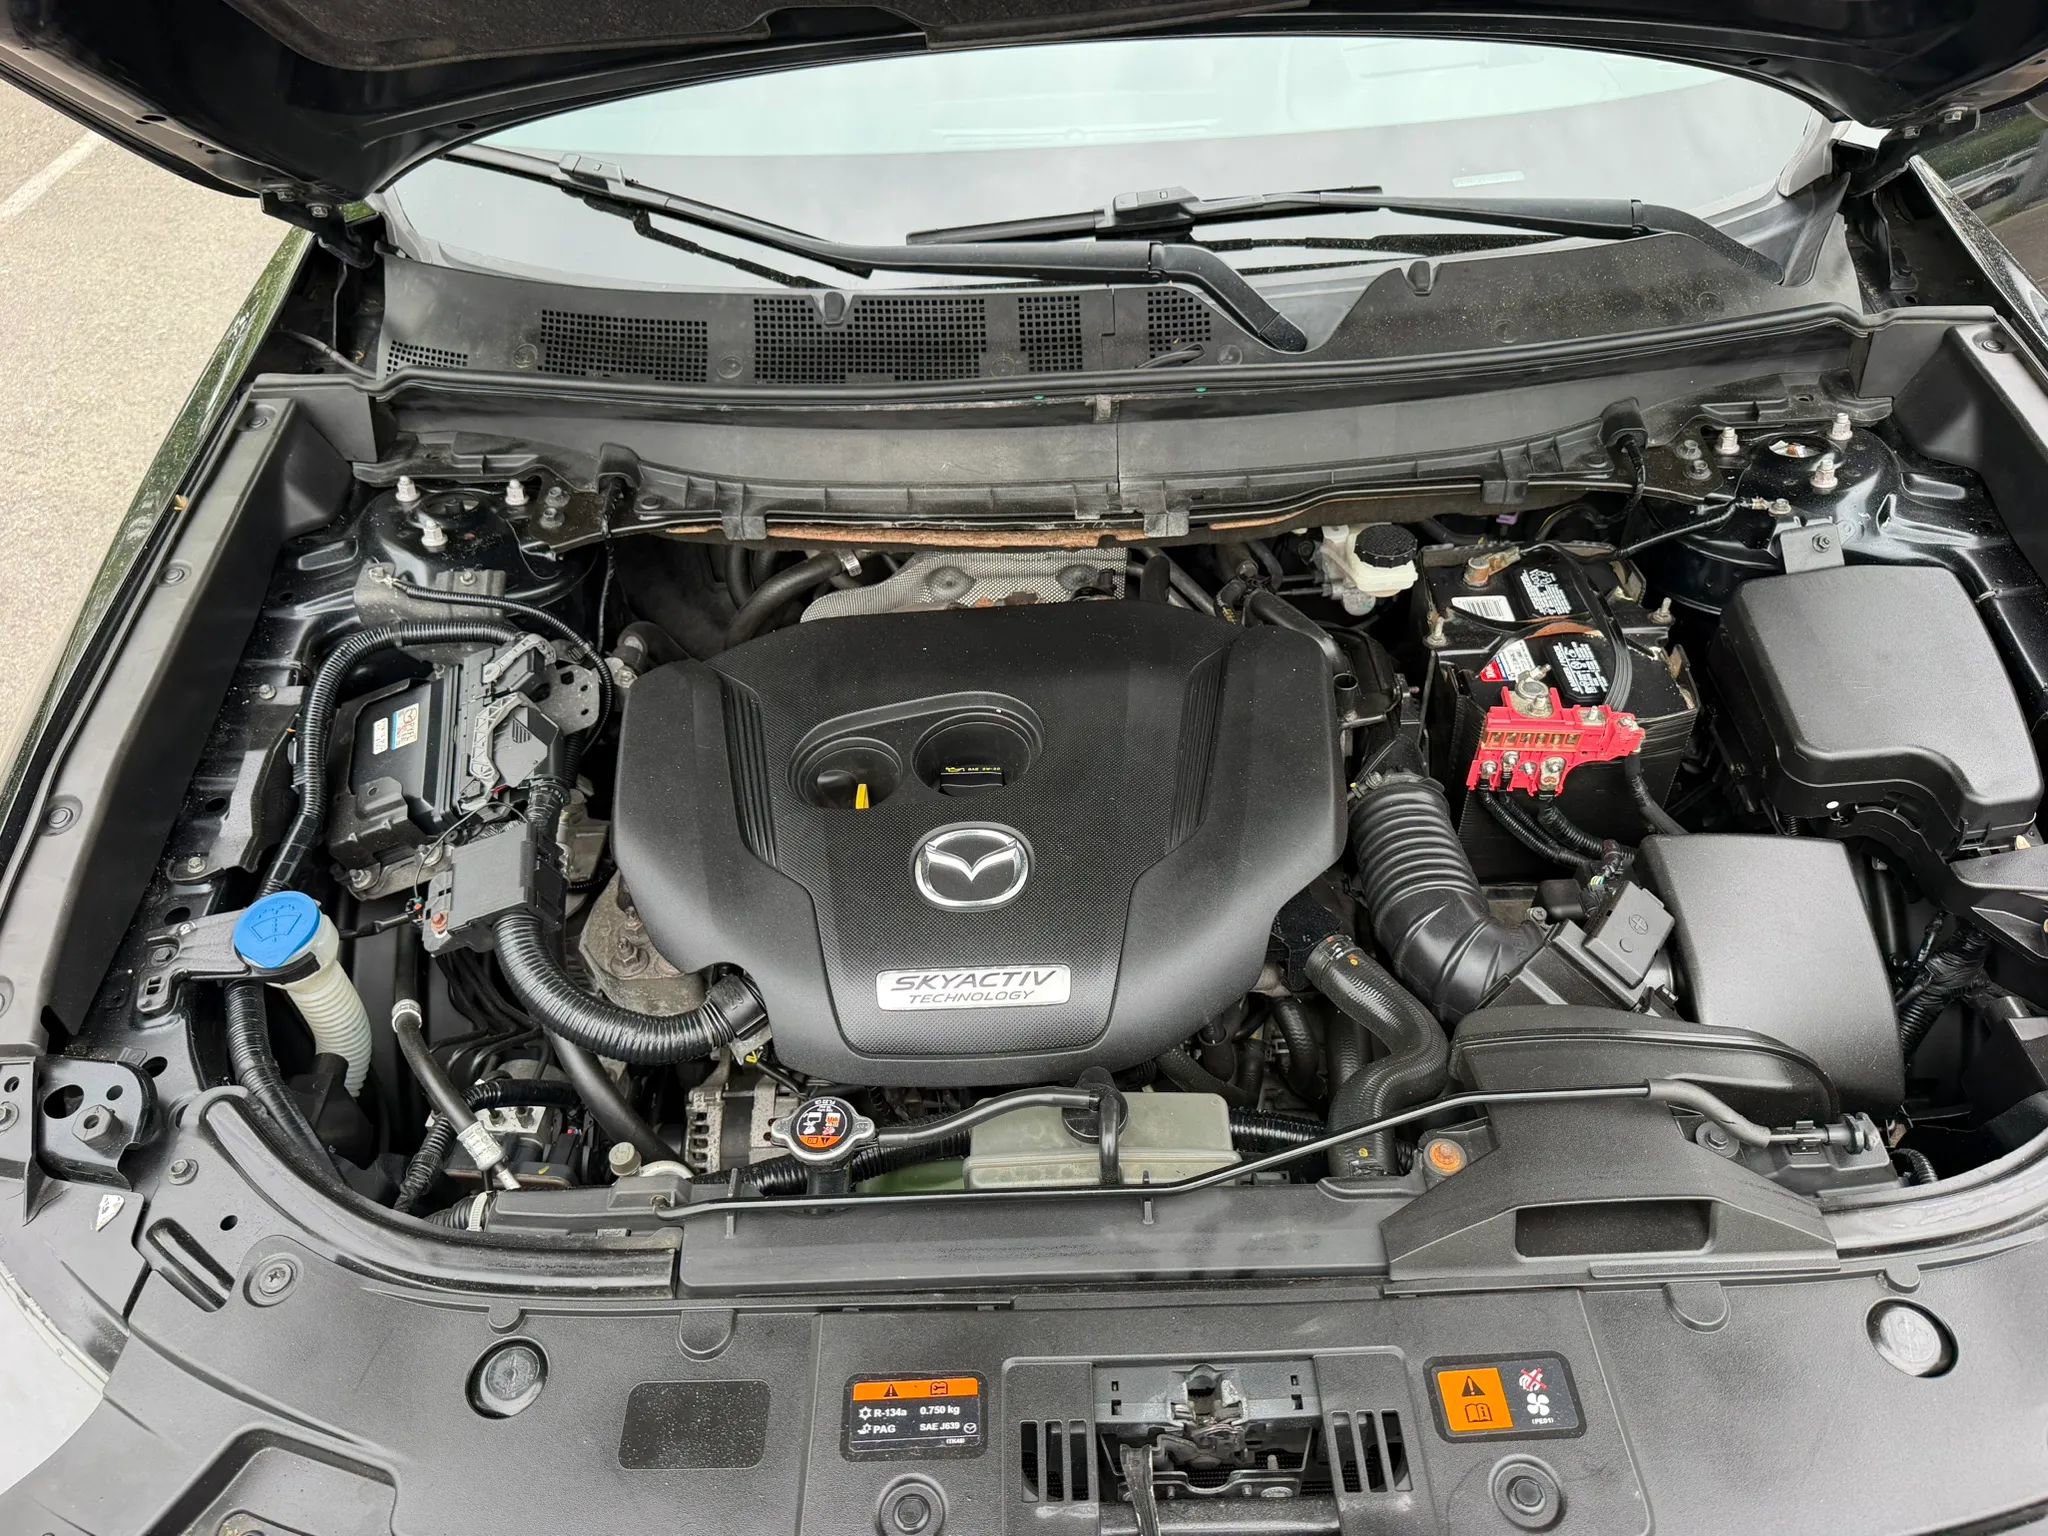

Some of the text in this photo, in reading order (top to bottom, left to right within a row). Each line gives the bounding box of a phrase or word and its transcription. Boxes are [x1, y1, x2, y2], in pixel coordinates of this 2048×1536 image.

[890, 970, 1057, 991] SKYACTIV
[909, 990, 1035, 1004] TECHNOLOGY
[873, 1405, 960, 1418] R-134a 0.750 kg
[873, 1422, 960, 1434] PAG SAE J639
